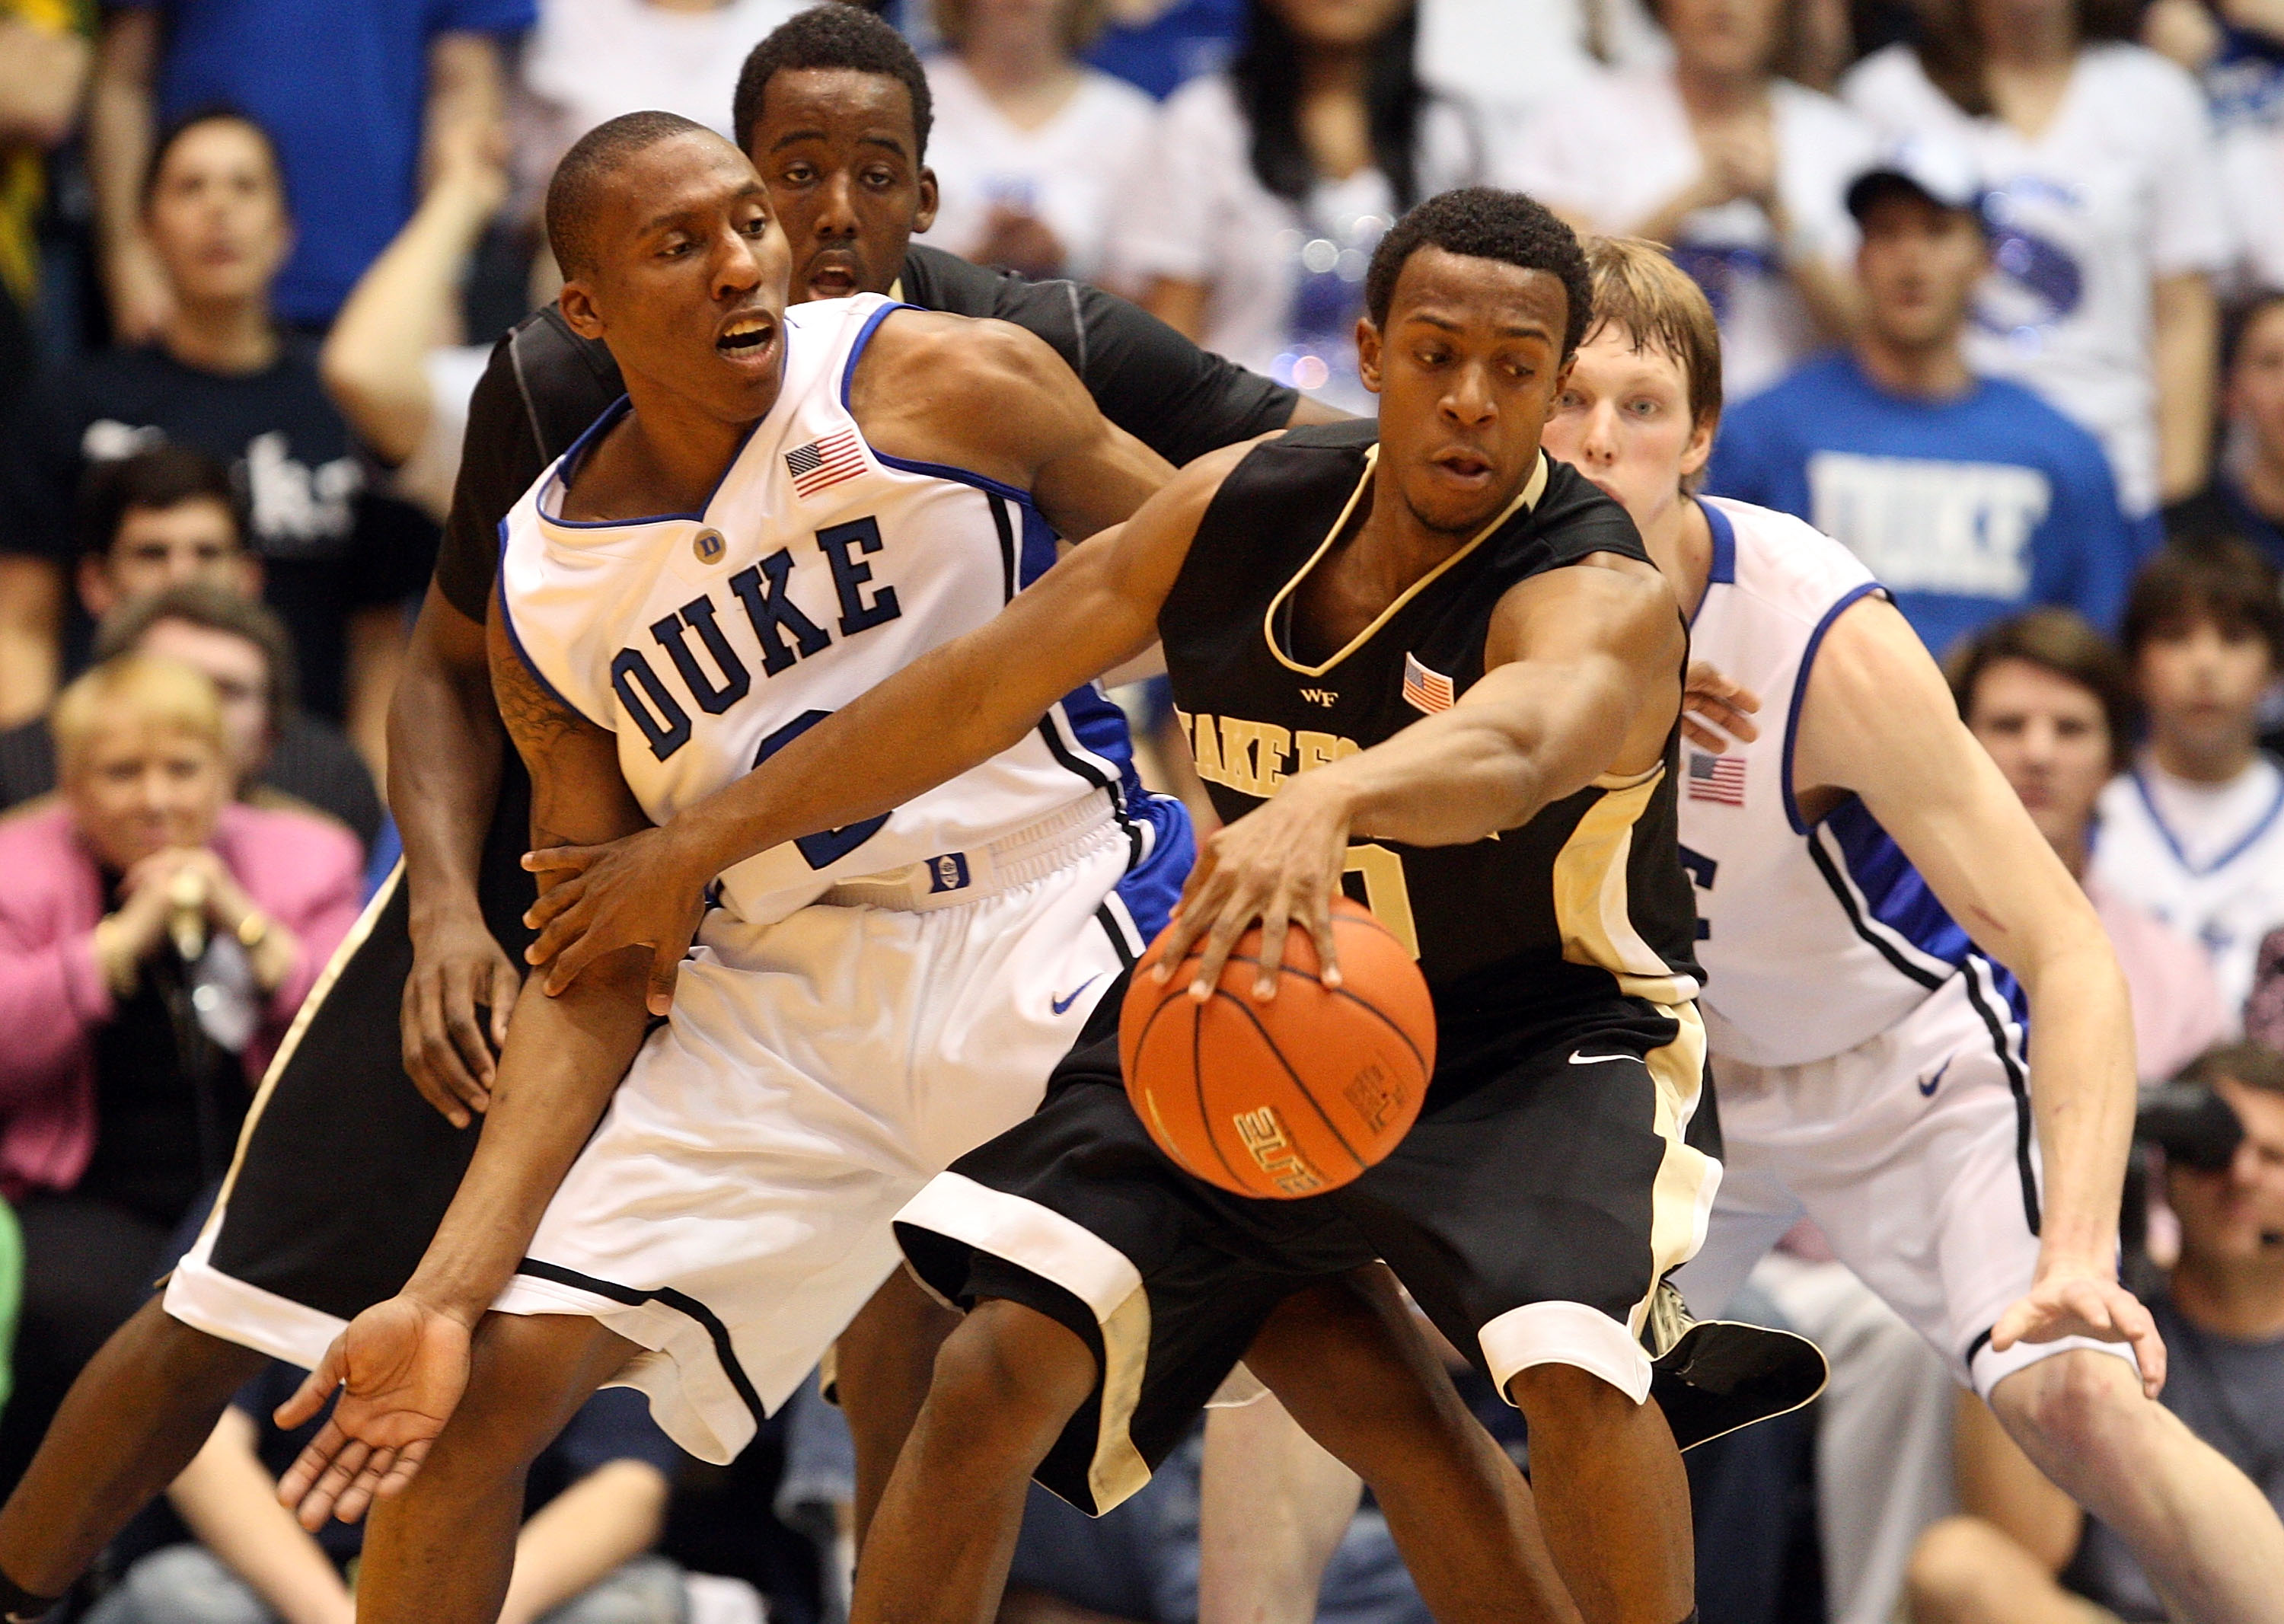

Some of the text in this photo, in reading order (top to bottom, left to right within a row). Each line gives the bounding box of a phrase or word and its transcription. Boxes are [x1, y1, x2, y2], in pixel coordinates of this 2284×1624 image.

[611, 515, 901, 762] DUKE
[1299, 688, 1339, 707] WF
[1233, 1106, 1324, 1193] ELITE
